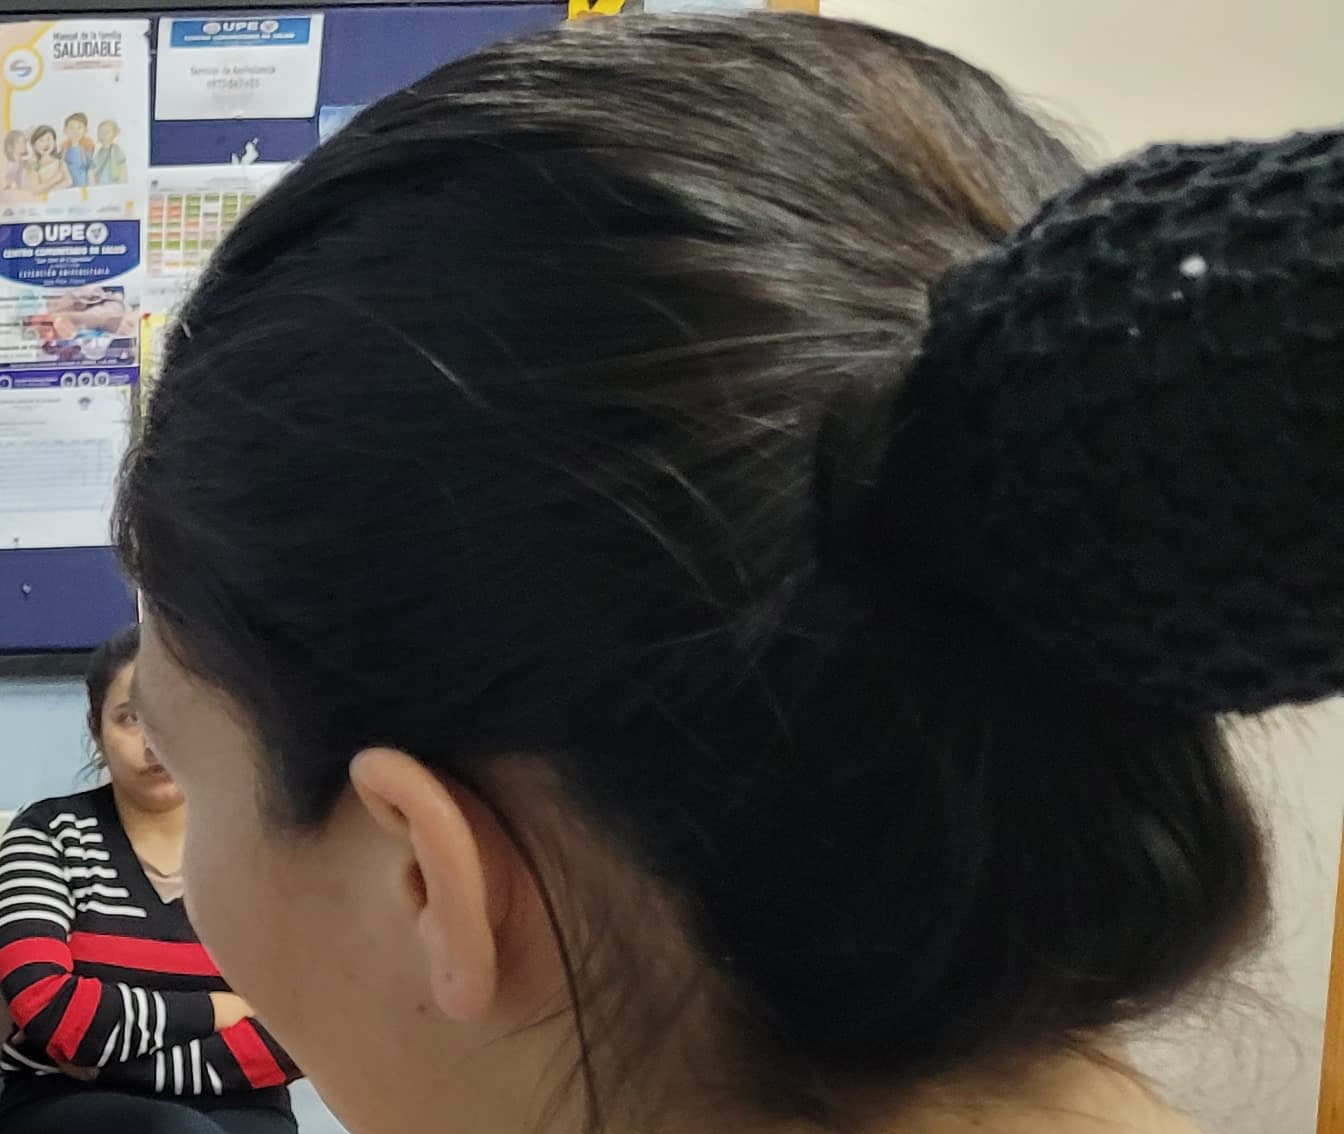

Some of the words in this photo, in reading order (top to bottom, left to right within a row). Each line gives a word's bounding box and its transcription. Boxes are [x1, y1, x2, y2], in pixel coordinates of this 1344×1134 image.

[223, 21, 258, 31] UPE
[53, 41, 122, 58] SALUDABLE
[45, 224, 85, 241] UPE
